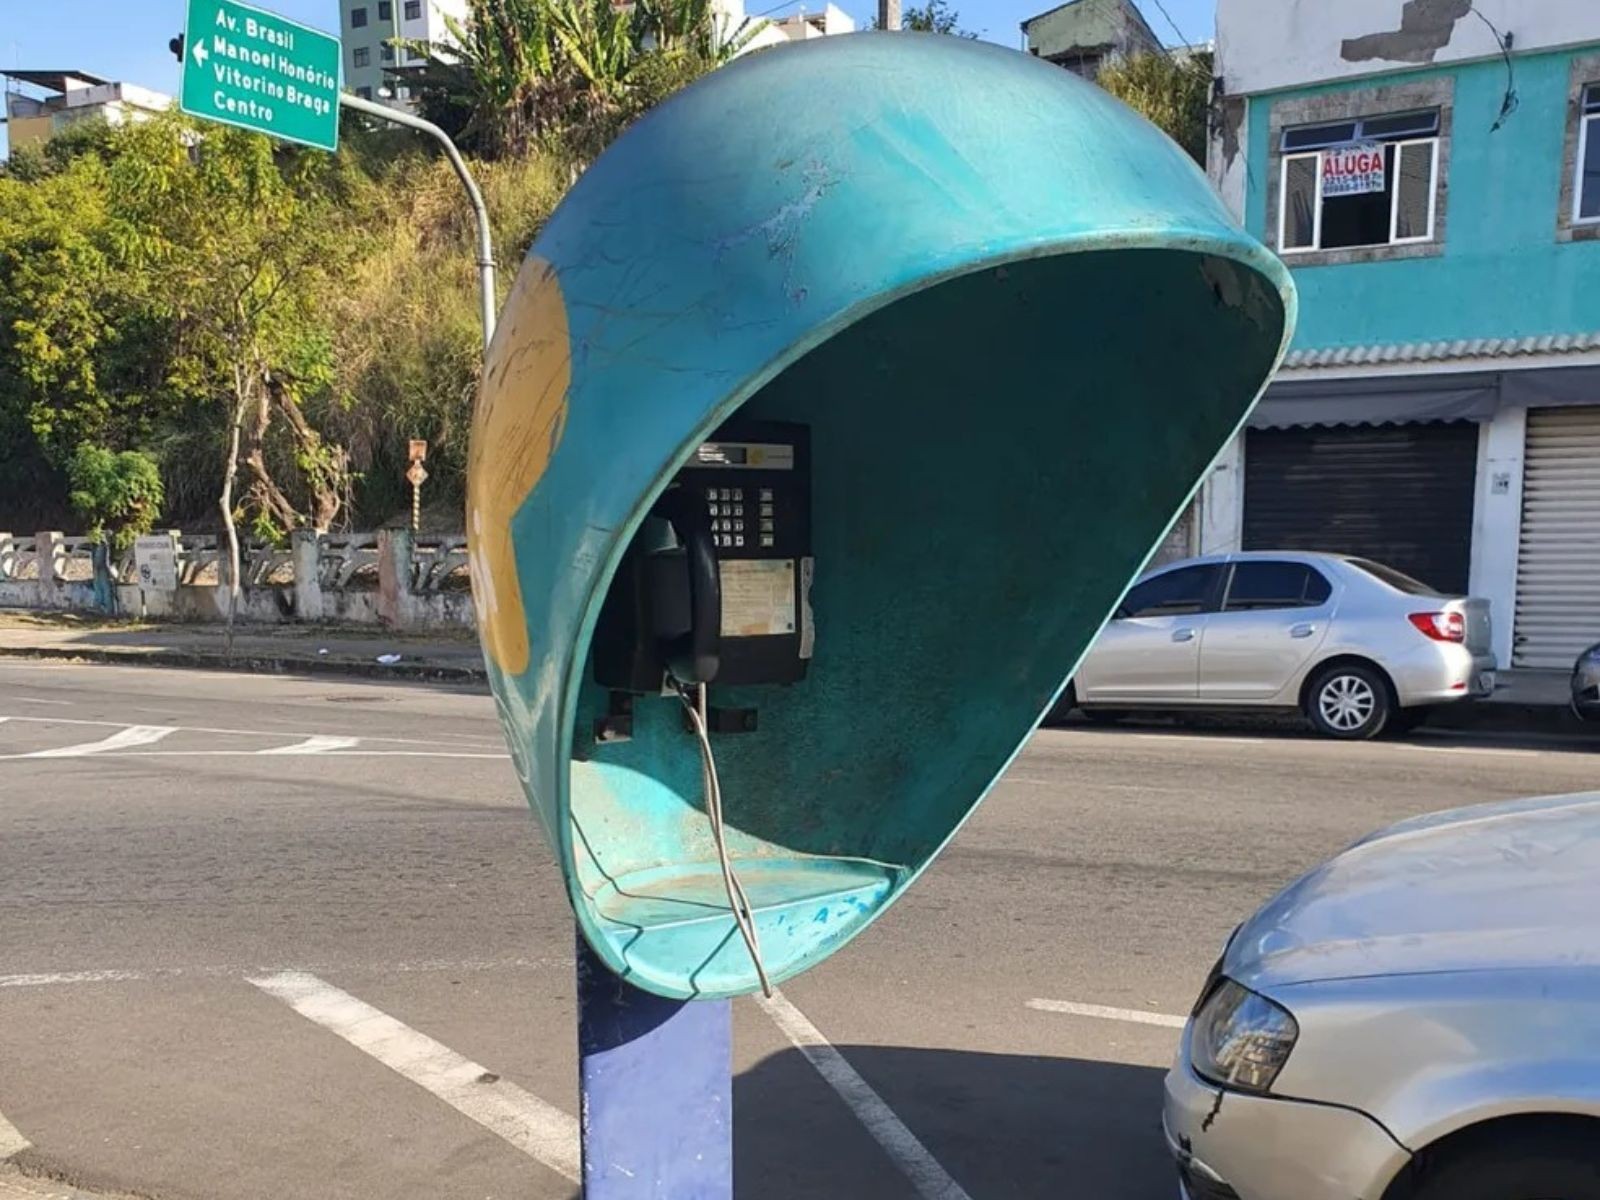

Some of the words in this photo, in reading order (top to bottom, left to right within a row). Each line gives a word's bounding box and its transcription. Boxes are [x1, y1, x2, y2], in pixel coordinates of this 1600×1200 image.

[216, 9, 240, 32] Av.
[246, 18, 294, 50] Brasil
[214, 35, 276, 69] Manoel
[279, 56, 334, 90] Honório
[214, 63, 283, 98] Vitorino
[287, 86, 330, 115] Braga
[214, 91, 272, 121] Centro
[1323, 153, 1382, 177] ALUGA
